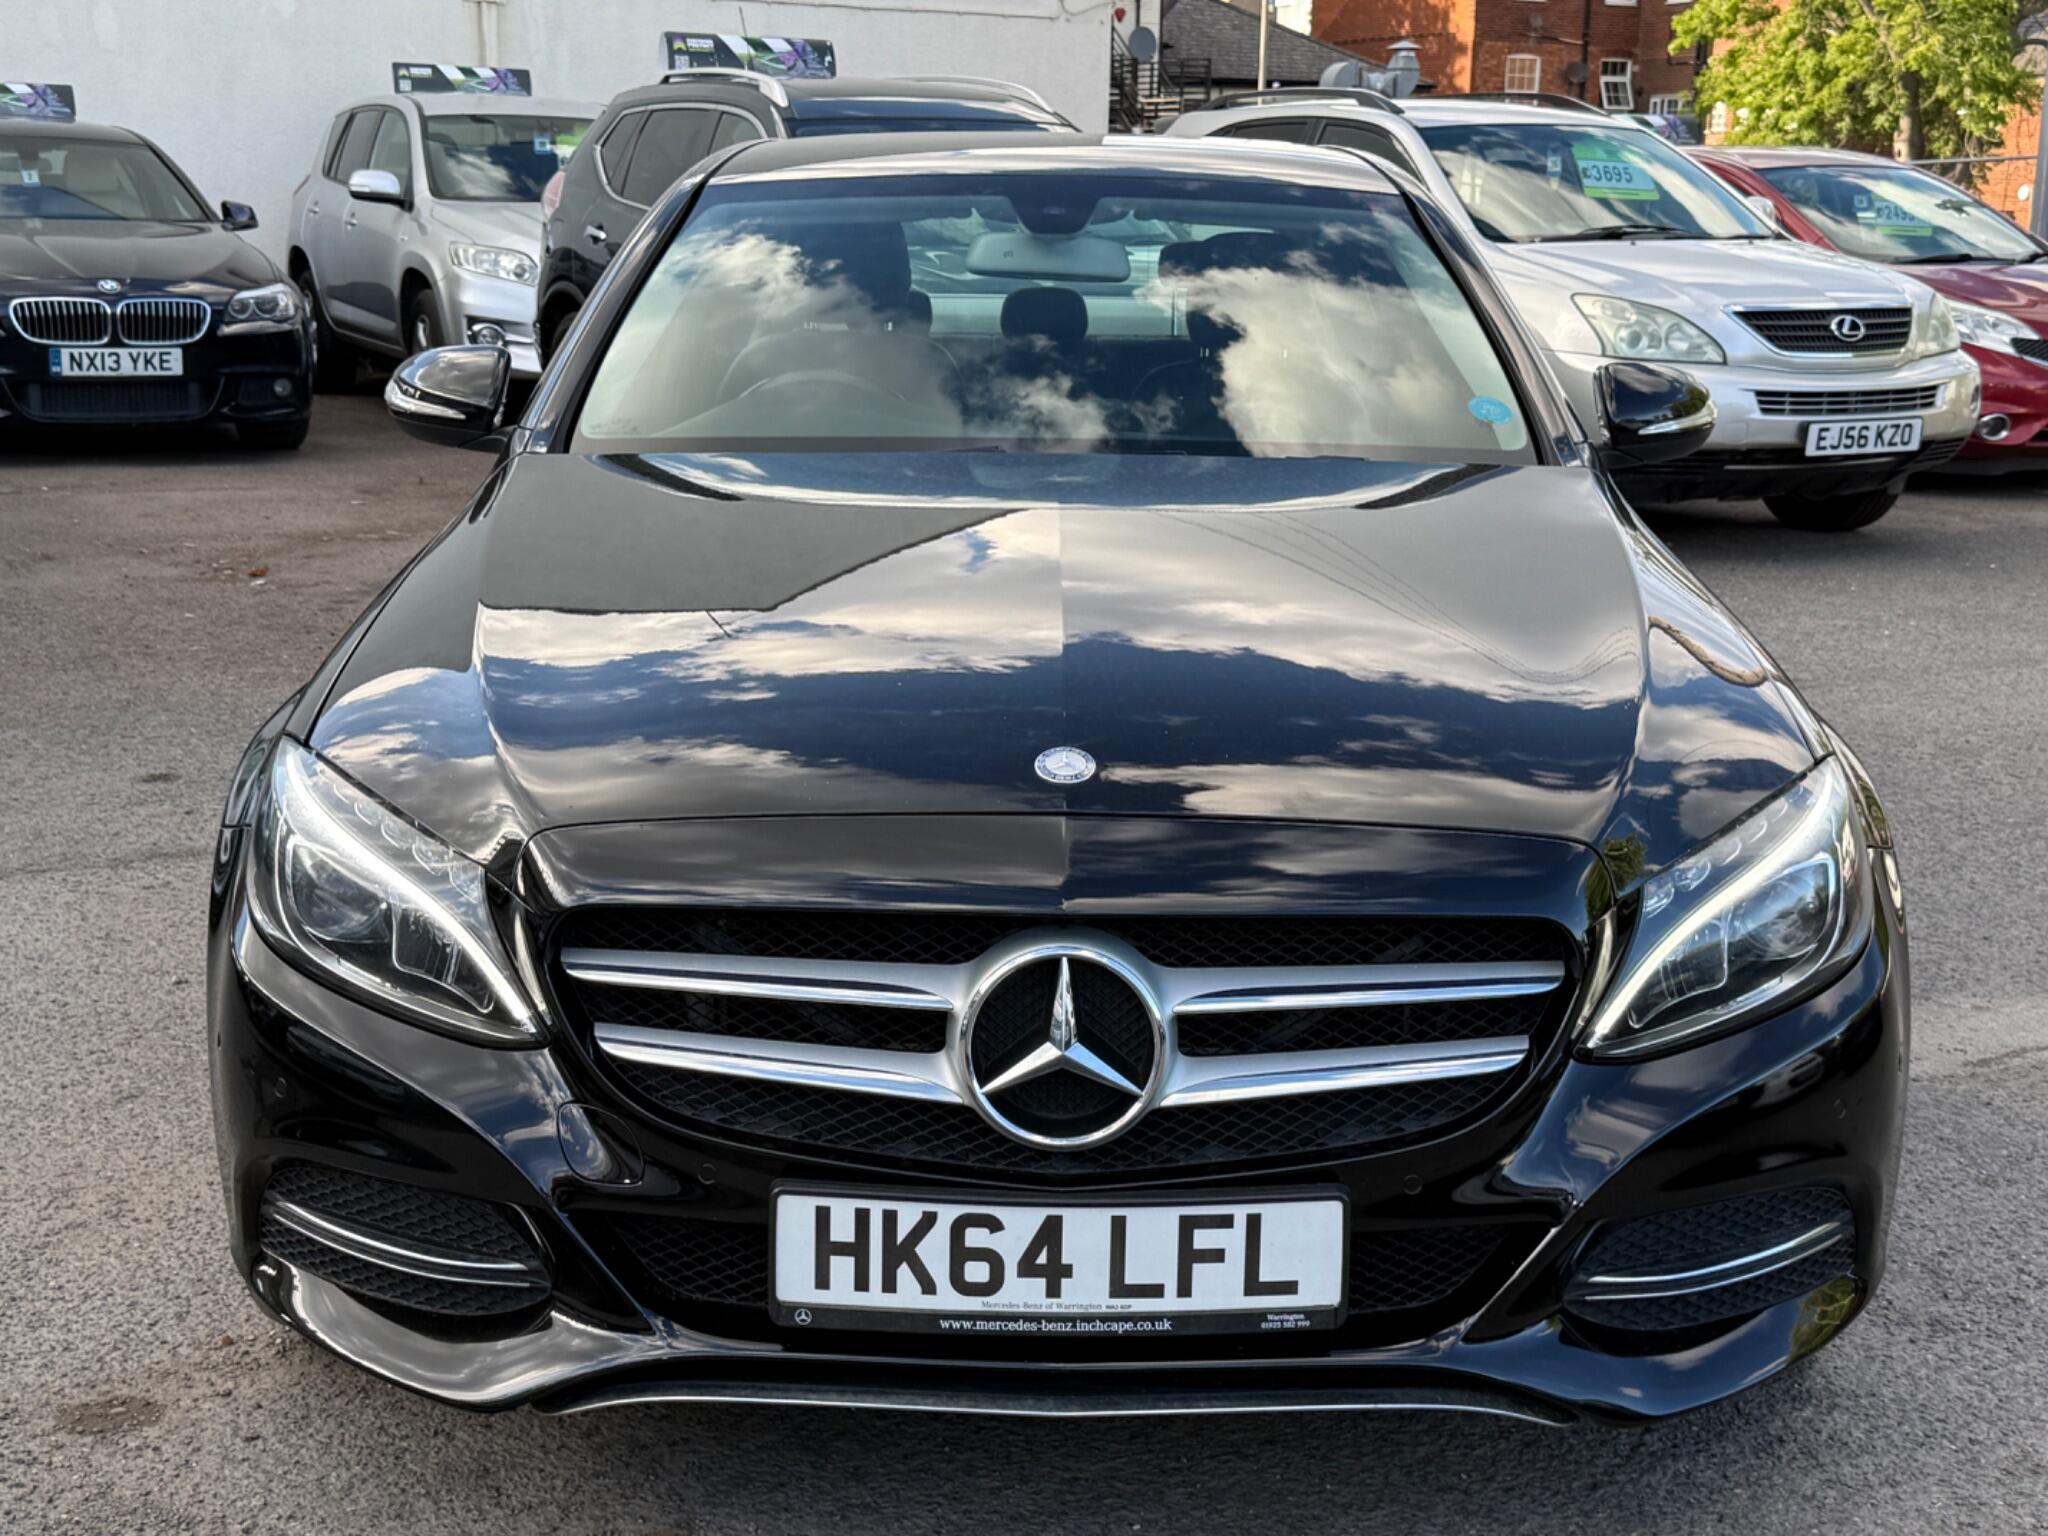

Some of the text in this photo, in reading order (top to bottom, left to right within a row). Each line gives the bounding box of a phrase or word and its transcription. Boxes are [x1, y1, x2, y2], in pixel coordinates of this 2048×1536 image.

[1581, 164, 1633, 183] £3695
[69, 351, 173, 372] NX13 YKE
[1815, 425, 1870, 451] EJ56
[814, 1205, 1299, 1299] HK64 LFL
[939, 1317, 1173, 1333] www.mercedes-benz.inchcape.co.uk
